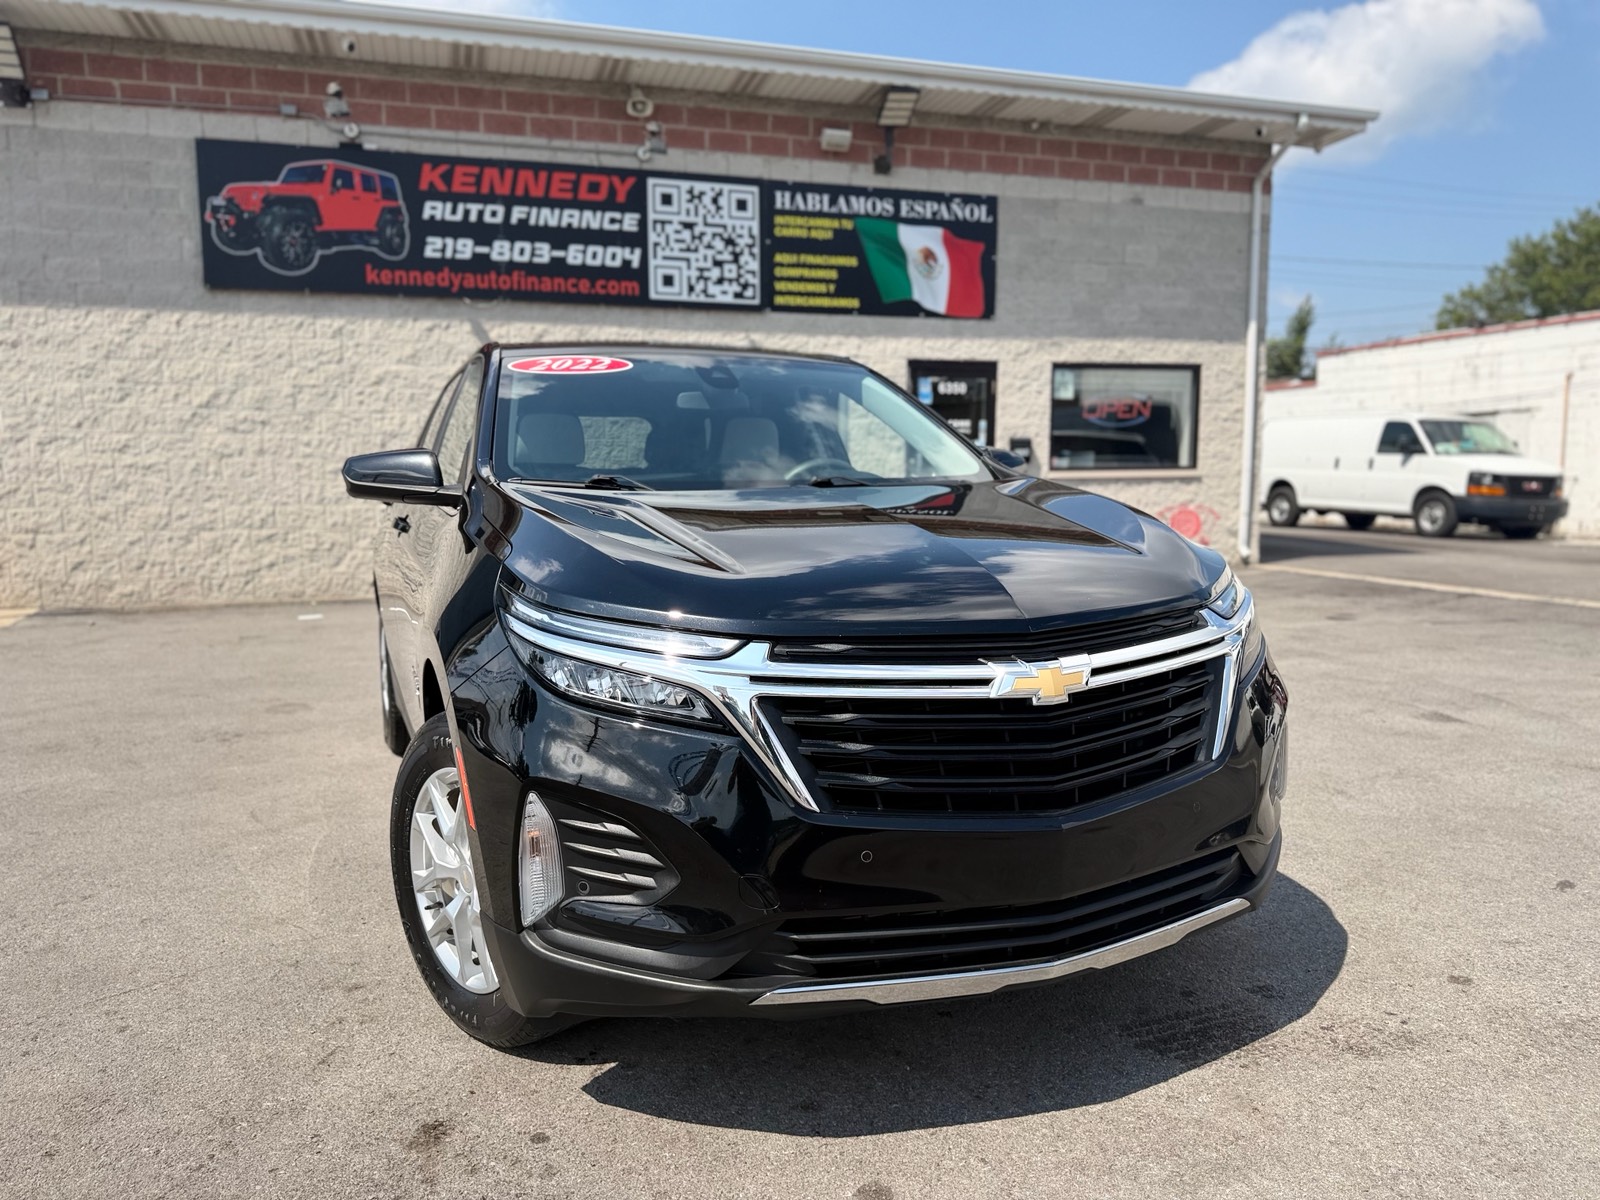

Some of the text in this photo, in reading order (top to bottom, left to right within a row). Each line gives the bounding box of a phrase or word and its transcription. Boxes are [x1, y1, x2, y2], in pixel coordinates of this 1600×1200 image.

[419, 163, 637, 203] KENNEDY
[422, 200, 641, 232] AUTO FINANCE
[774, 190, 994, 223] HABLAMOS ESPAÑOL
[424, 236, 642, 269] 219-803-6004
[365, 263, 640, 296] kennedyautofinance.com
[529, 358, 611, 371] 2022
[1082, 399, 1153, 420] OPEN
